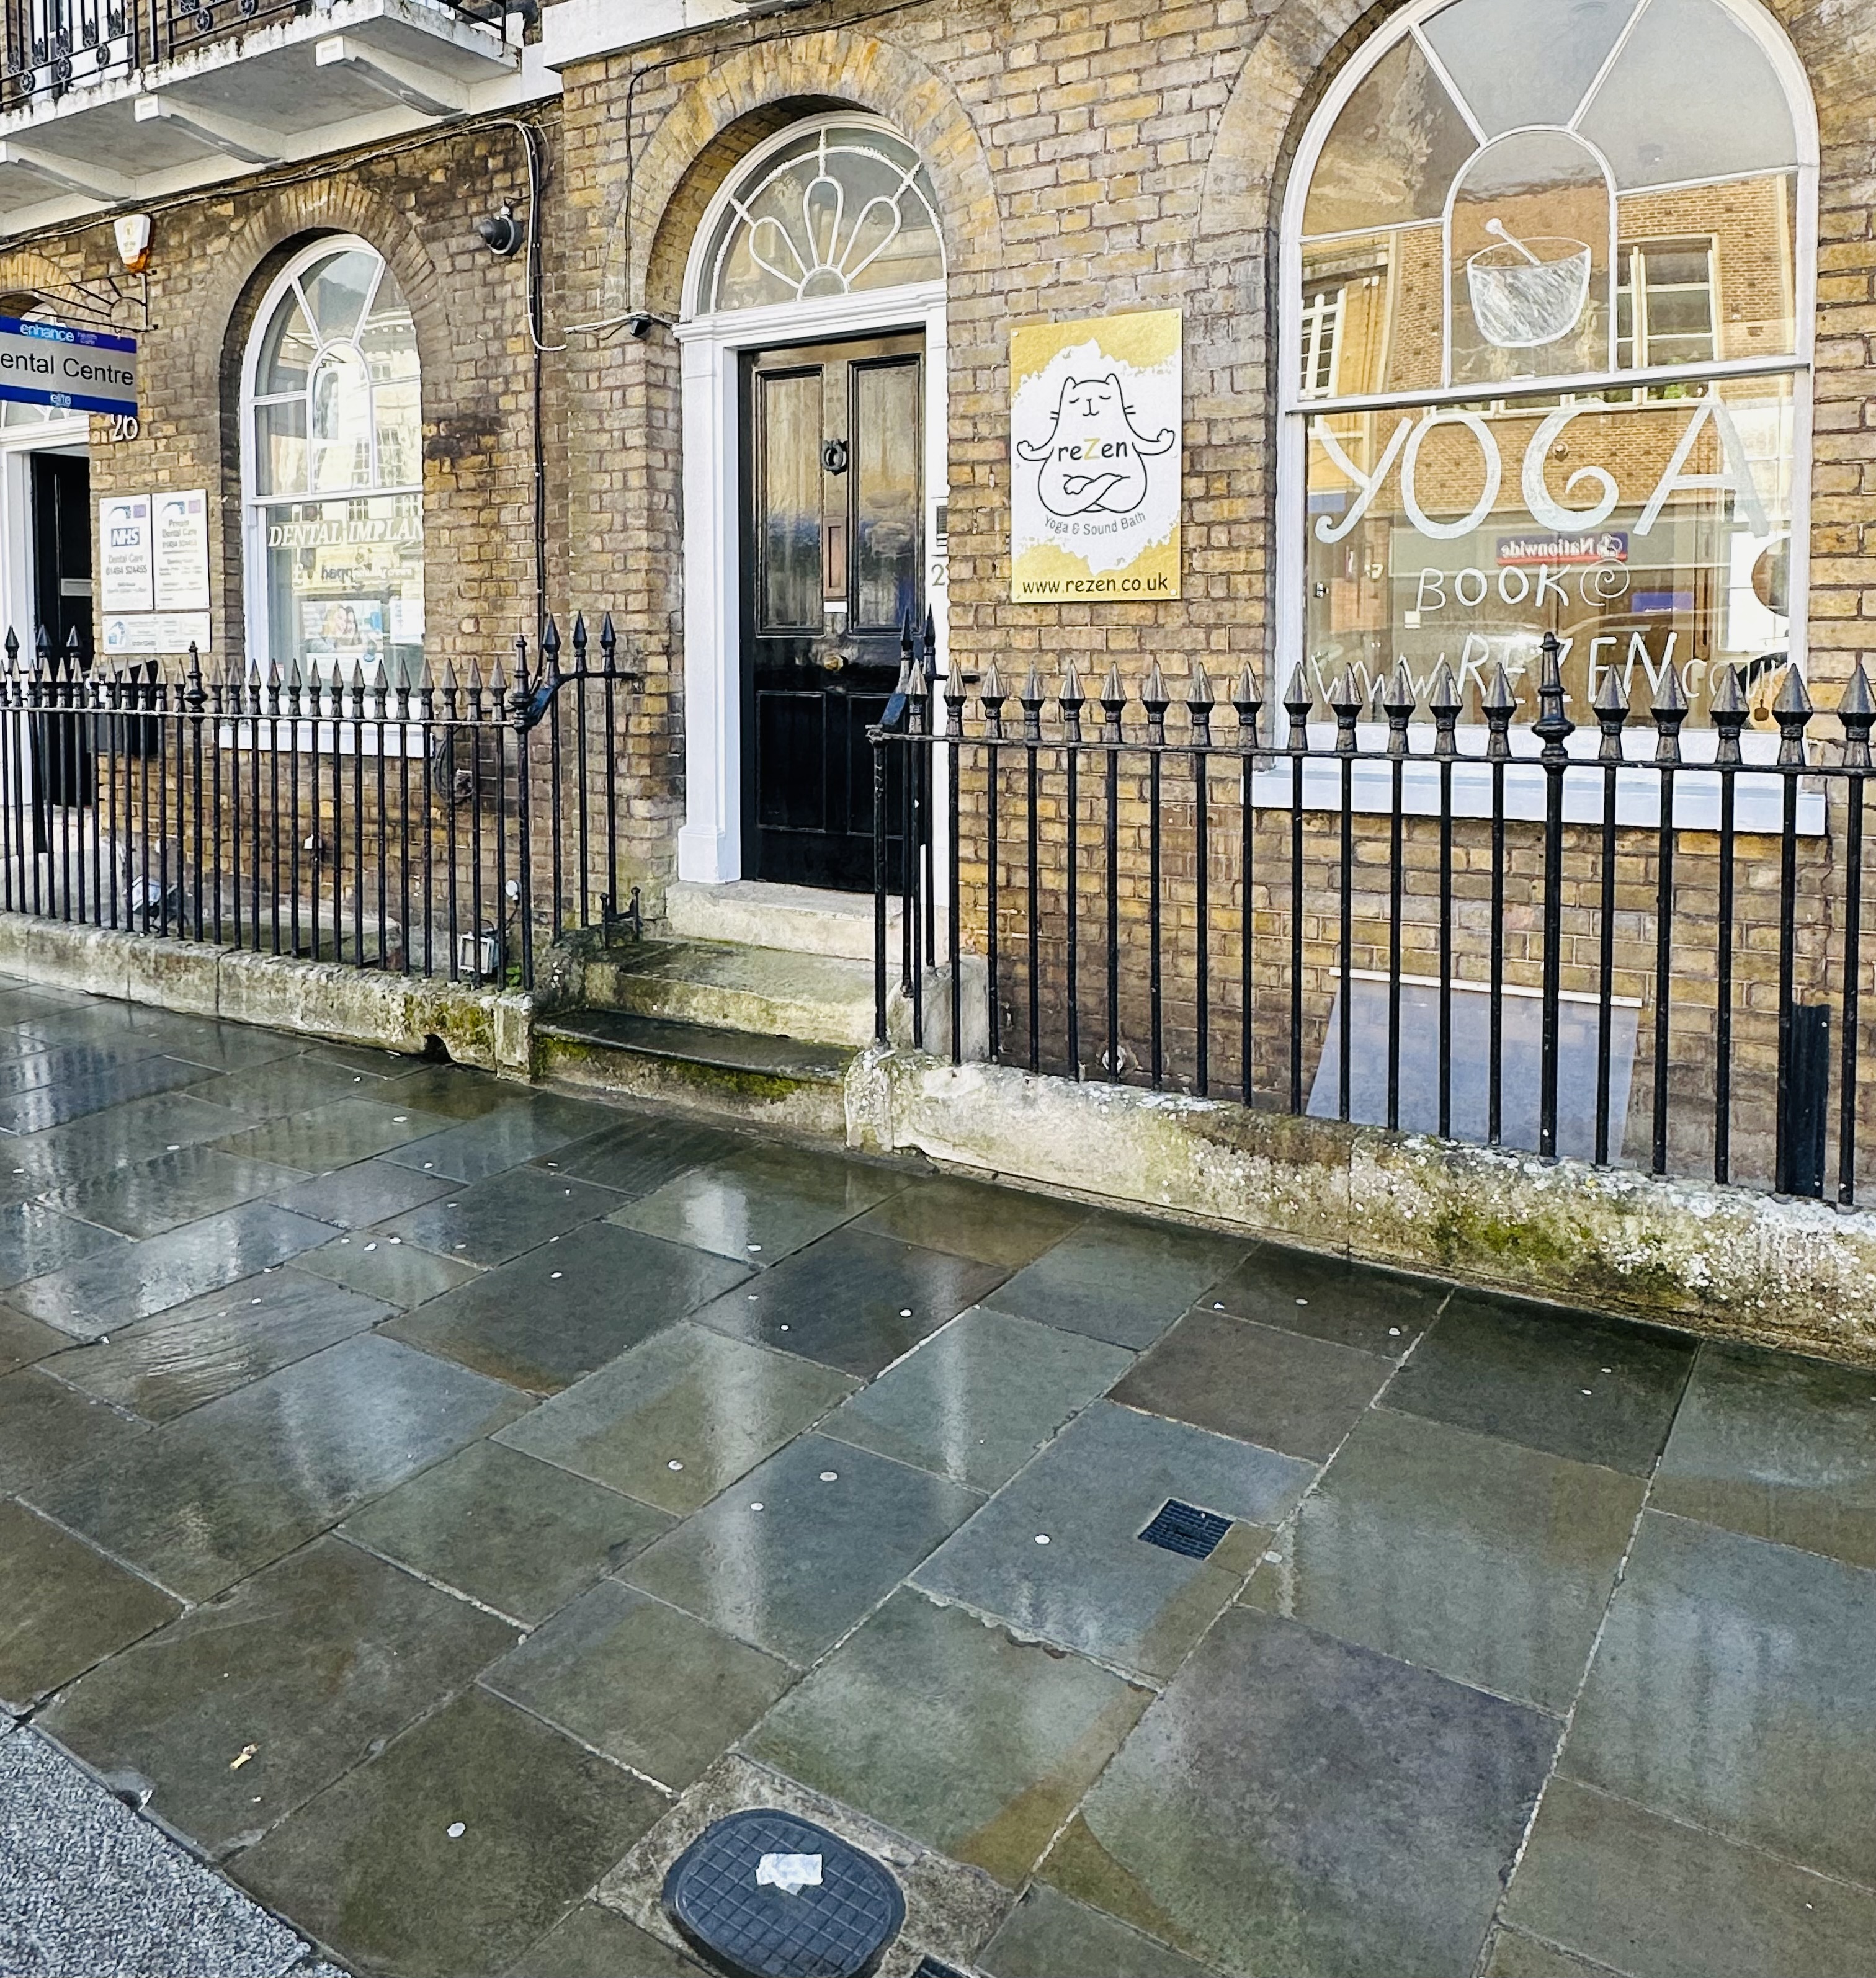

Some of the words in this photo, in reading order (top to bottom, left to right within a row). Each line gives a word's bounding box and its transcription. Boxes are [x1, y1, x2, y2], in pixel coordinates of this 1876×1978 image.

[20, 324, 74, 342] enhance
[63, 358, 134, 385] Centre
[111, 414, 139, 440] 20
[1057, 438, 1128, 462] reZen
[1315, 392, 1769, 543] YOGA
[268, 522, 342, 546] DENTAL
[1043, 514, 1068, 534] Yoga
[1072, 523, 1080, 535] &
[1083, 519, 1117, 535] Sound
[1122, 510, 1146, 532] Bath
[112, 529, 139, 546] NHS
[1022, 572, 1168, 594] www.rezen.co.uk
[1416, 563, 1571, 612] BOOK
